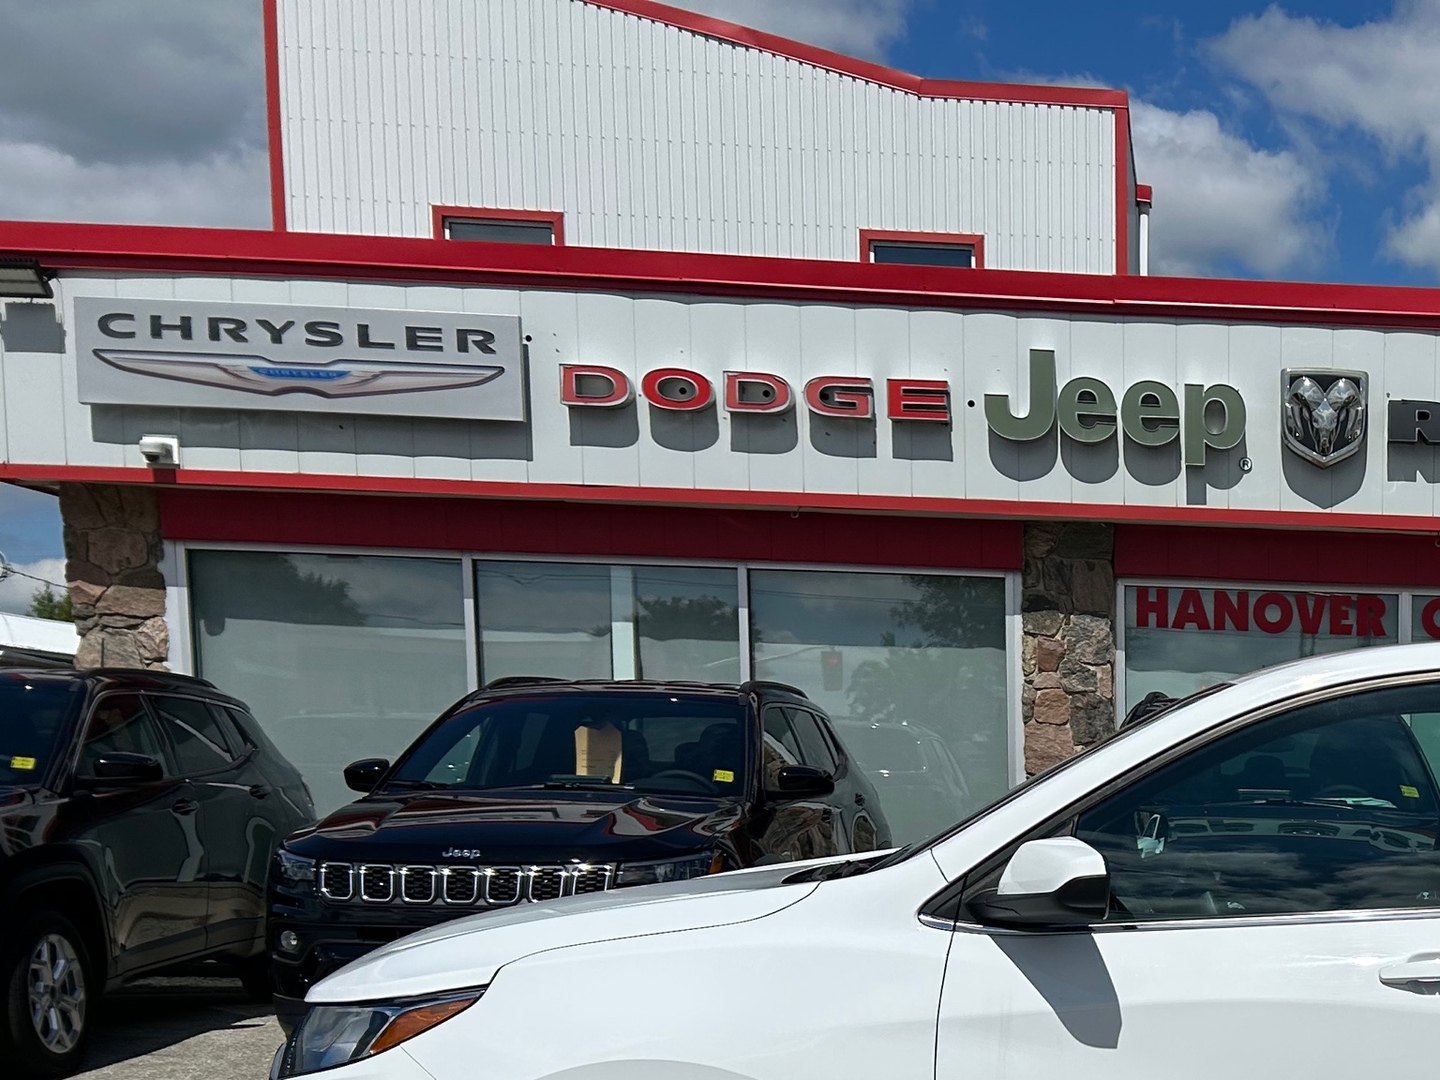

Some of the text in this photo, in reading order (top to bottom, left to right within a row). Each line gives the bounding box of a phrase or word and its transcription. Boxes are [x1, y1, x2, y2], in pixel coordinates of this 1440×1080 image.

[97, 312, 497, 355] CHRYSLER
[559, 363, 951, 423] DODGE
[983, 348, 1248, 466] Jeep
[1136, 586, 1388, 638] HANOVER
[441, 846, 481, 859] Jeep
